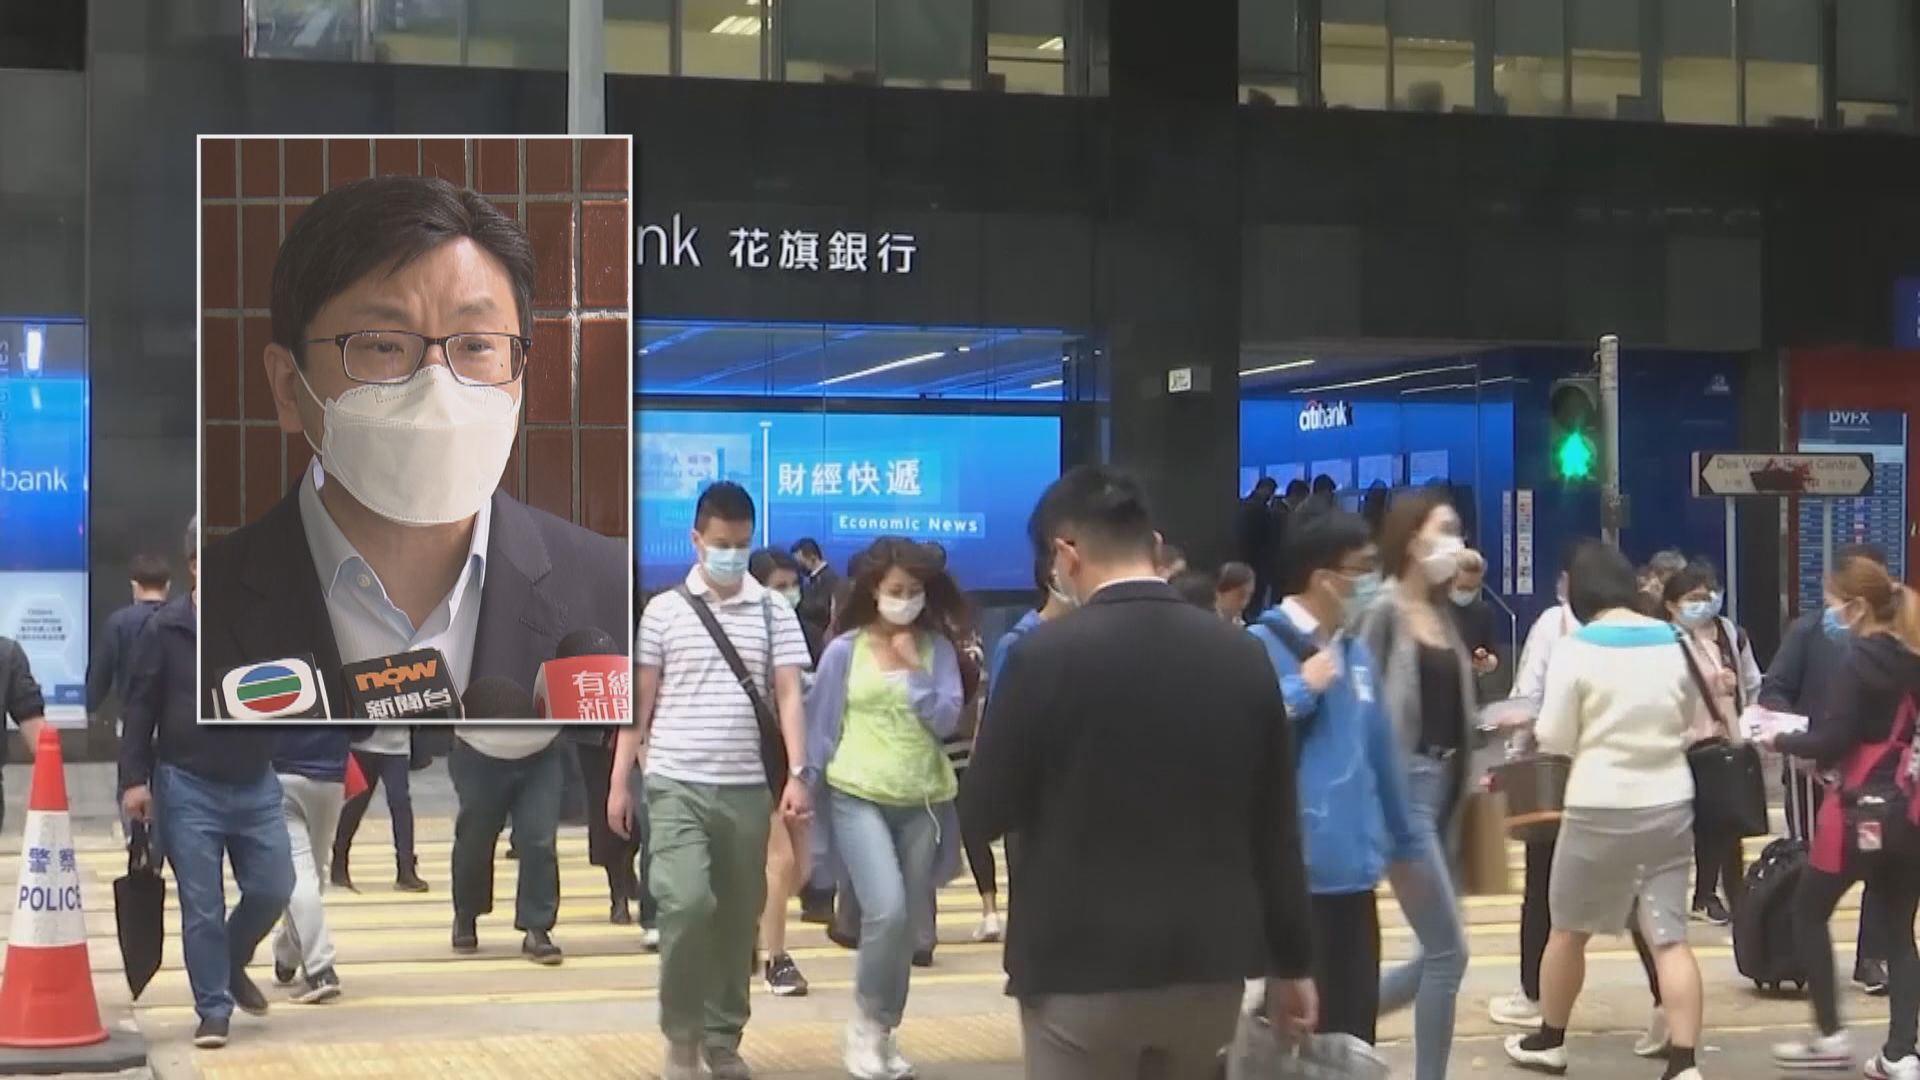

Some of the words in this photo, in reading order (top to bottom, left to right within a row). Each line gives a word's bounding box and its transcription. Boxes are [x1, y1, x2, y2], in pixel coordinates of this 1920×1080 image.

[729, 227, 917, 274] 花旗銀行
[1299, 400, 1348, 431] citibank
[1829, 411, 1871, 424] DVFX
[777, 458, 922, 496] 財經快遞
[839, 515, 921, 531] Economic
[928, 517, 979, 534] News
[355, 658, 437, 692] now
[364, 688, 452, 720] 新聞台
[28, 847, 77, 873] 警察
